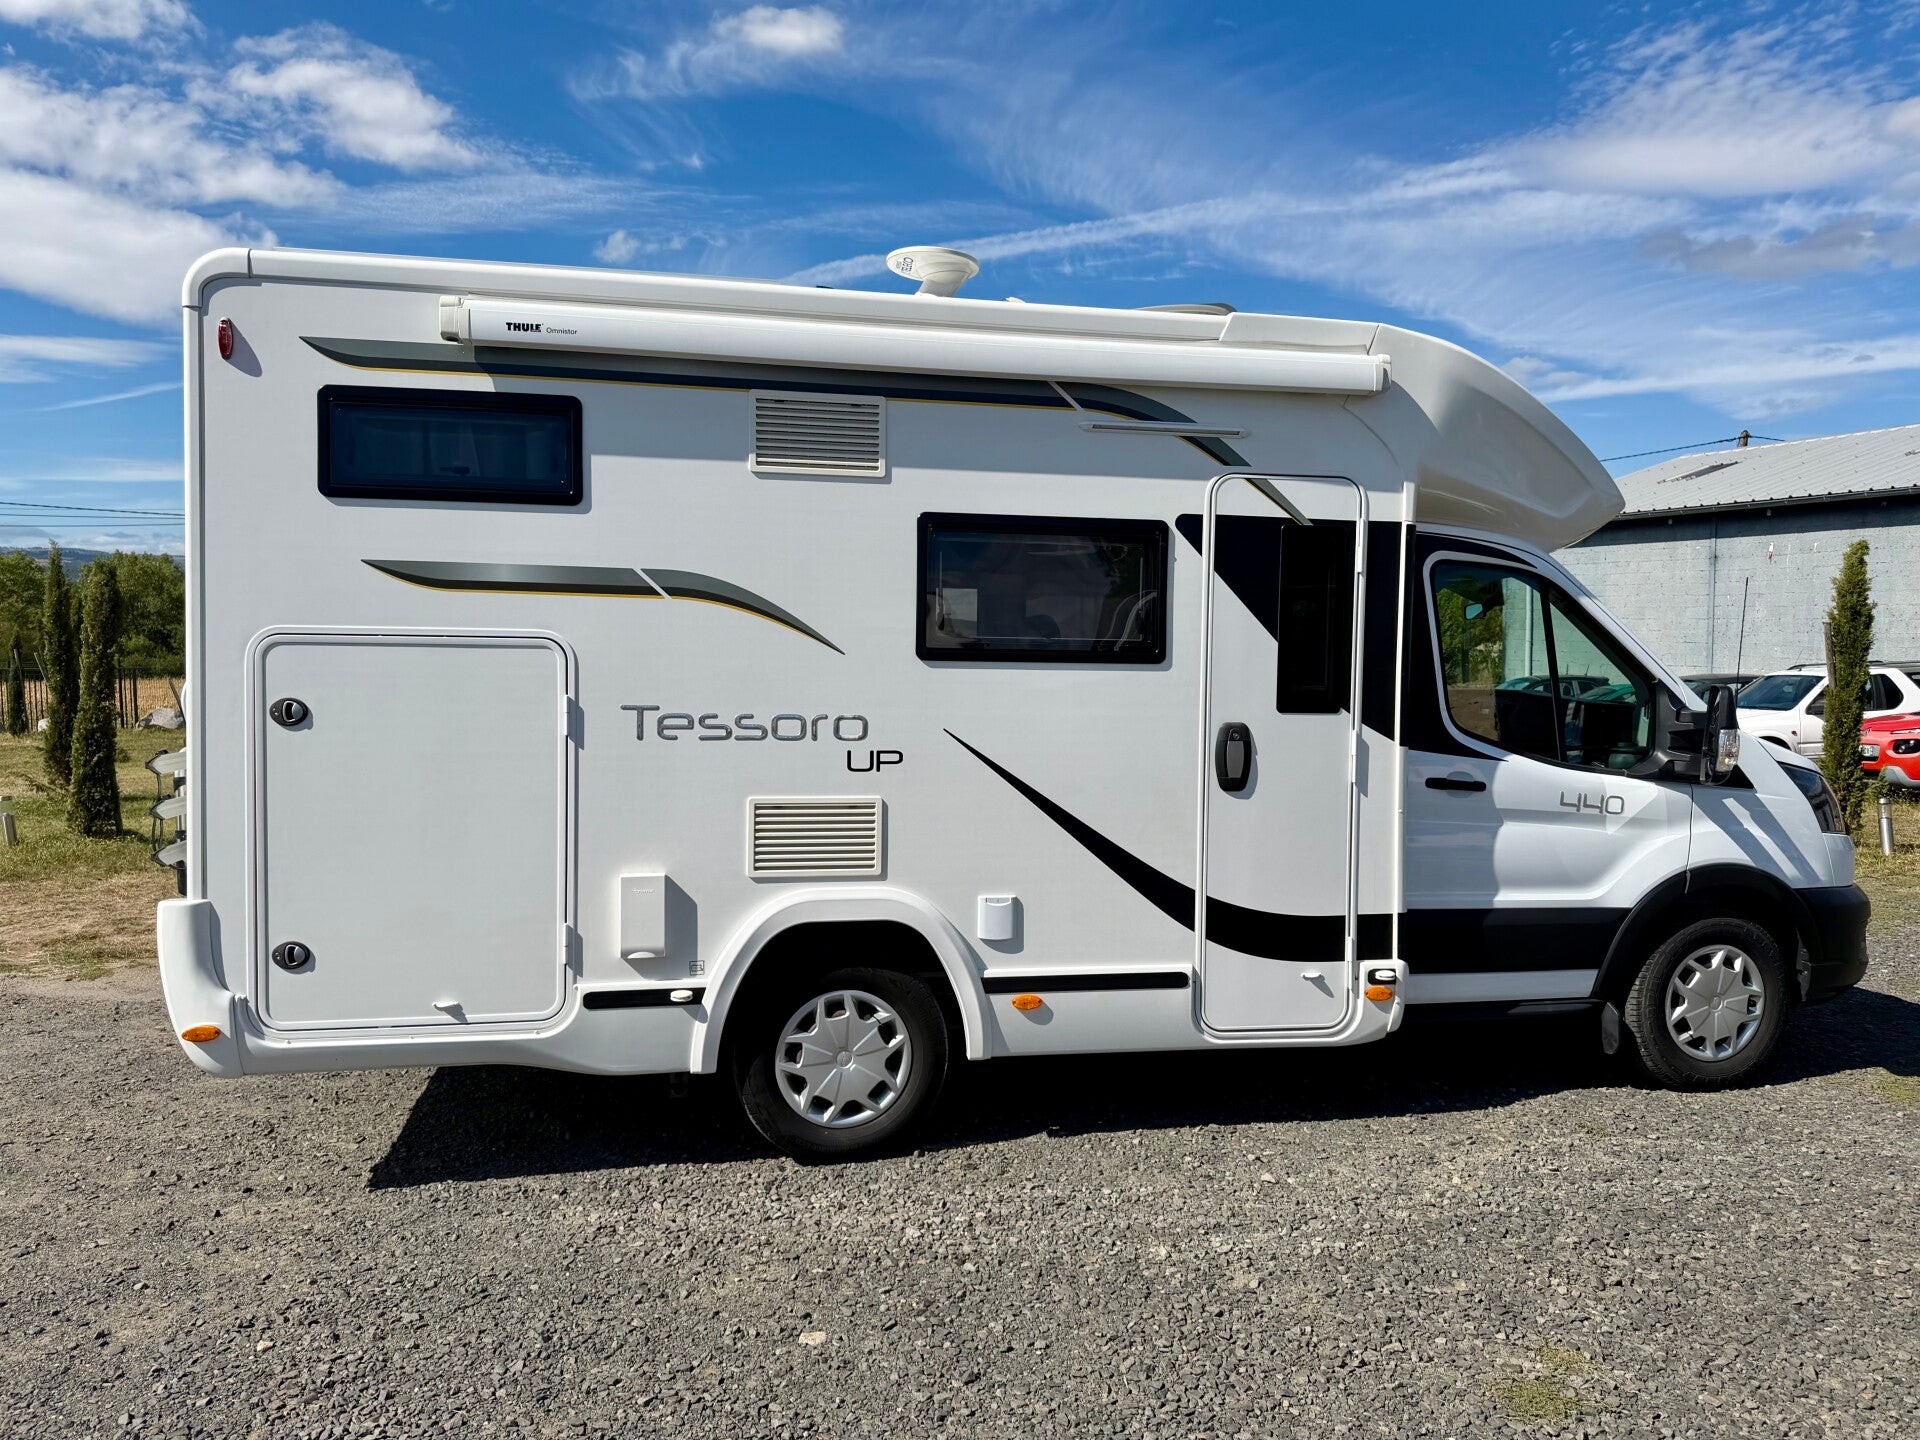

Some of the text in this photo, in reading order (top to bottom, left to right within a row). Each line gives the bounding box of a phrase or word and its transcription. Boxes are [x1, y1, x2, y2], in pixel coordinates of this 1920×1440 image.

[506, 322, 577, 335] THULE Omnistor
[620, 704, 868, 741] Tessoro
[846, 750, 904, 772] UP
[1559, 791, 1625, 815] 440
